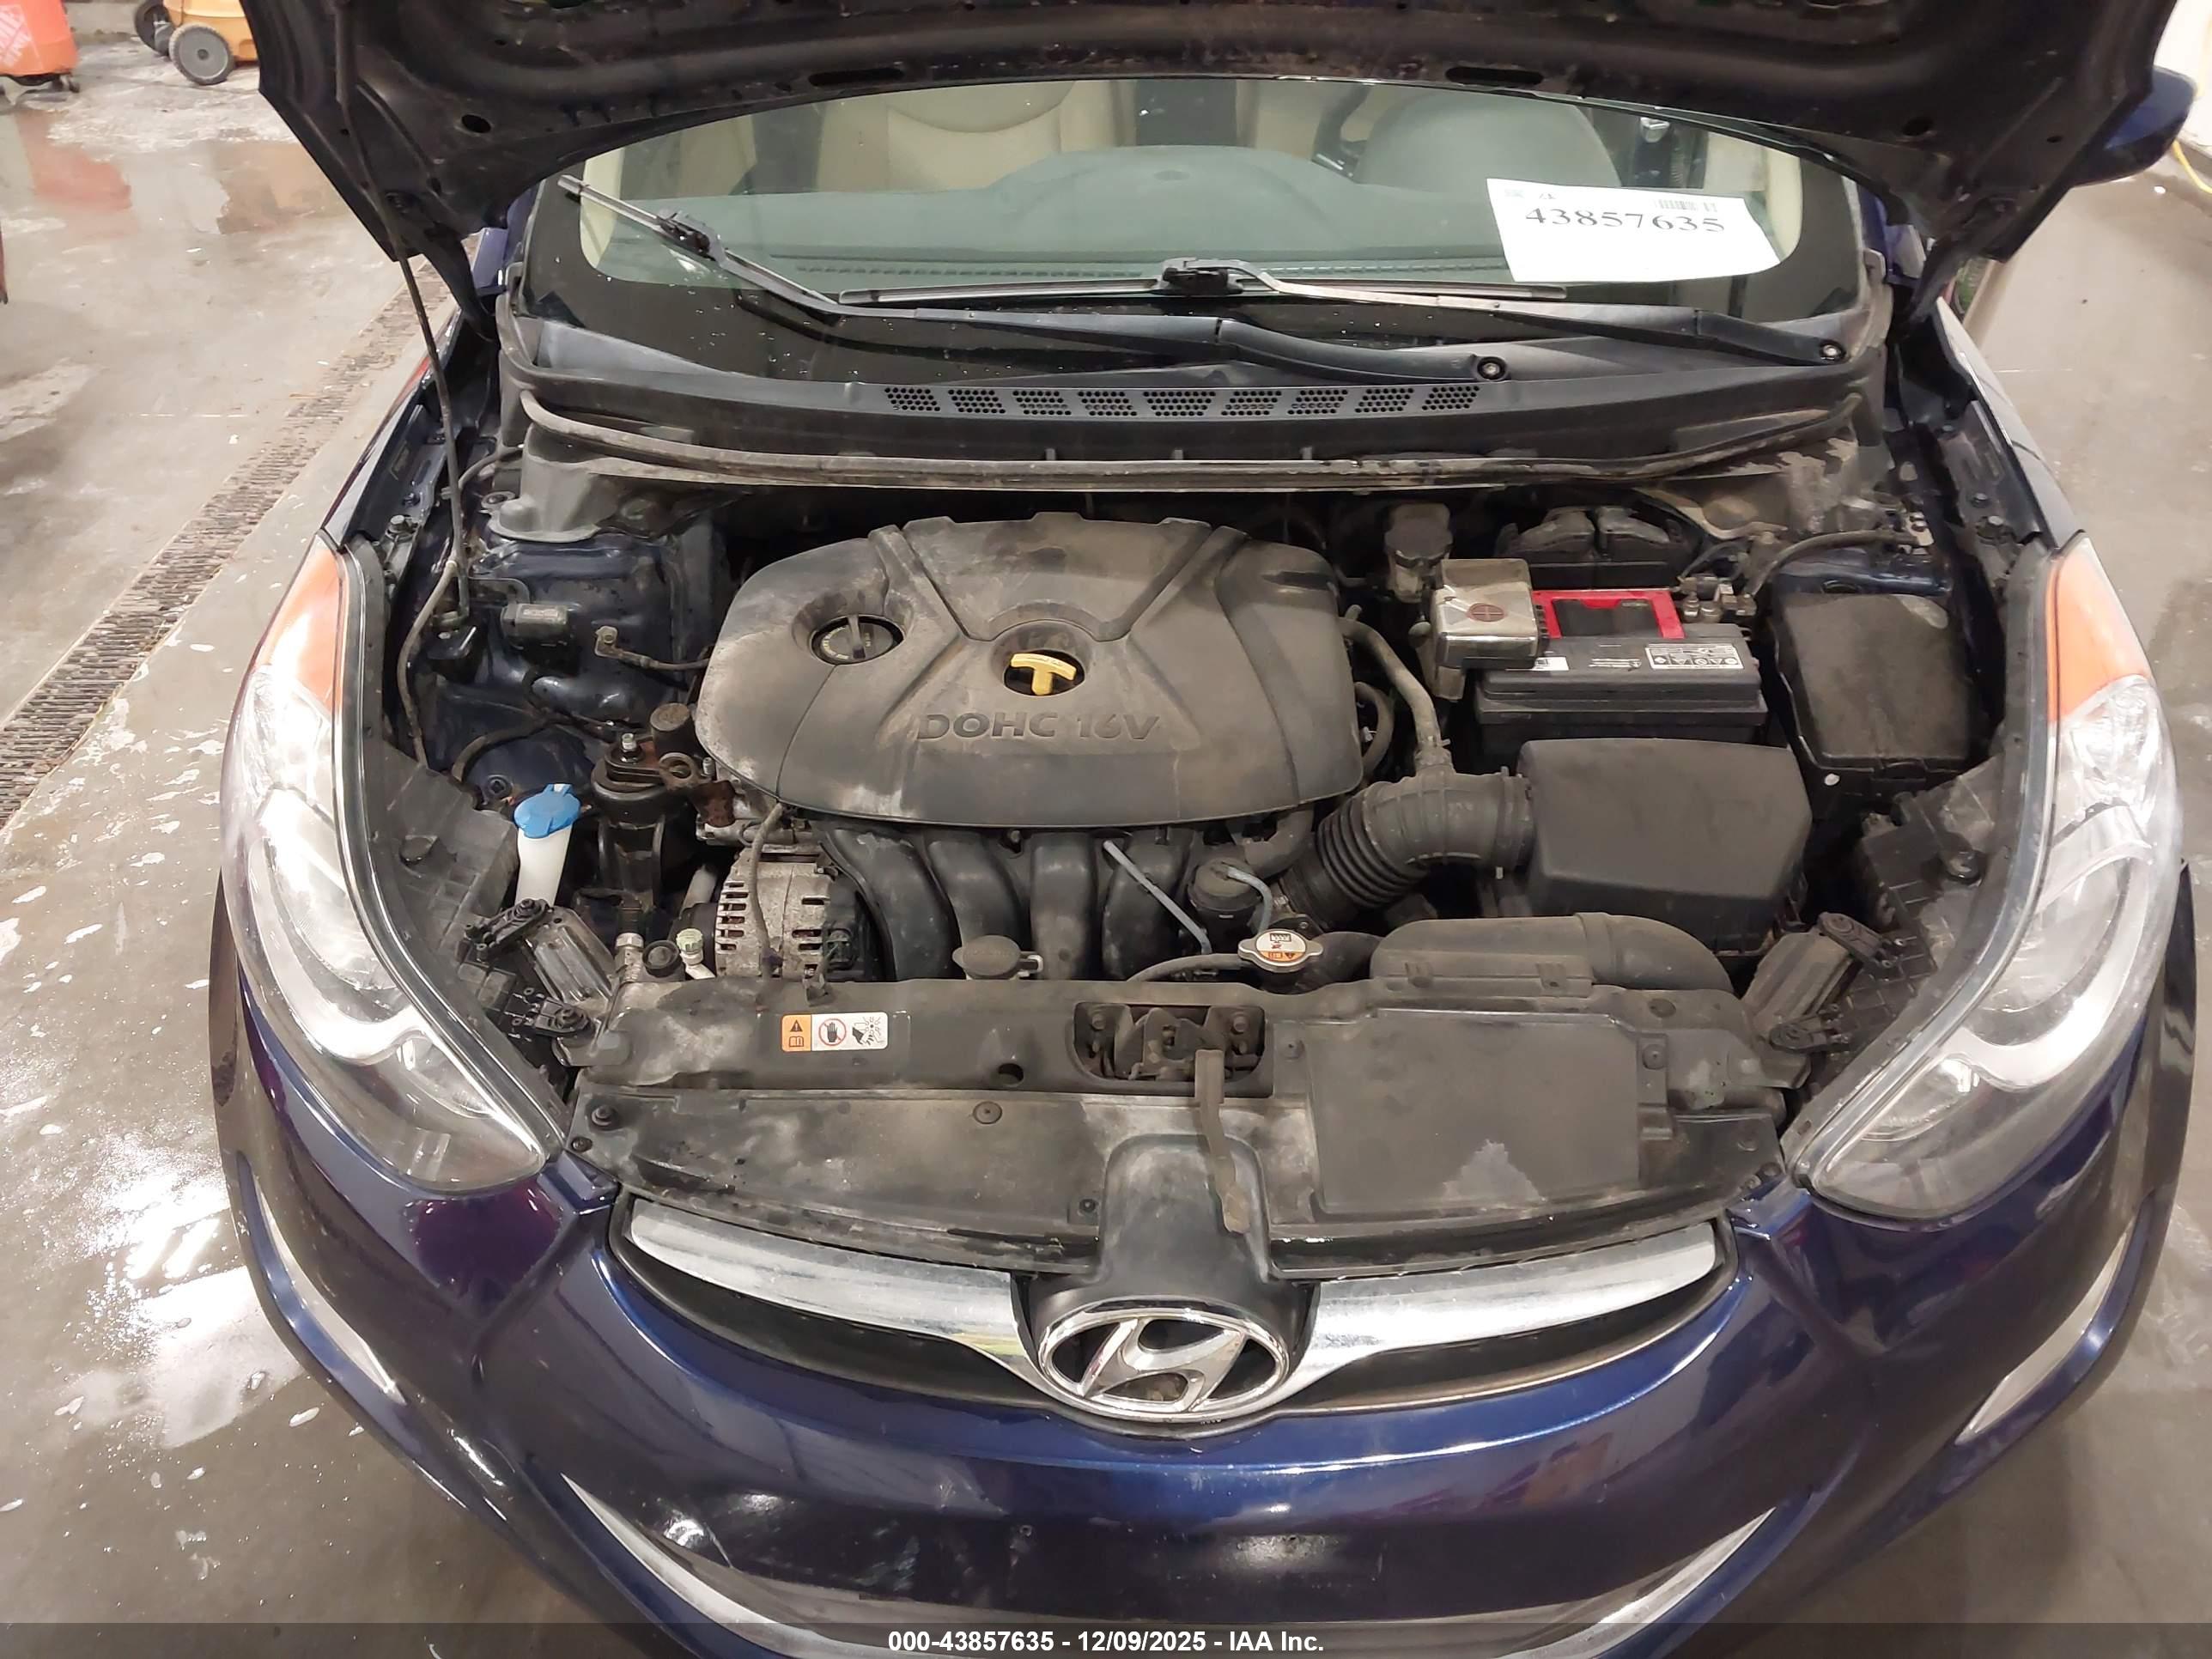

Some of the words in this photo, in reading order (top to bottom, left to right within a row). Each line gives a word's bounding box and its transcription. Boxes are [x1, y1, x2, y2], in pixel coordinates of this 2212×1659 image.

[1525, 208, 1725, 233] 43857635
[916, 712, 1059, 739] DOHC
[1077, 714, 1160, 740] 16V
